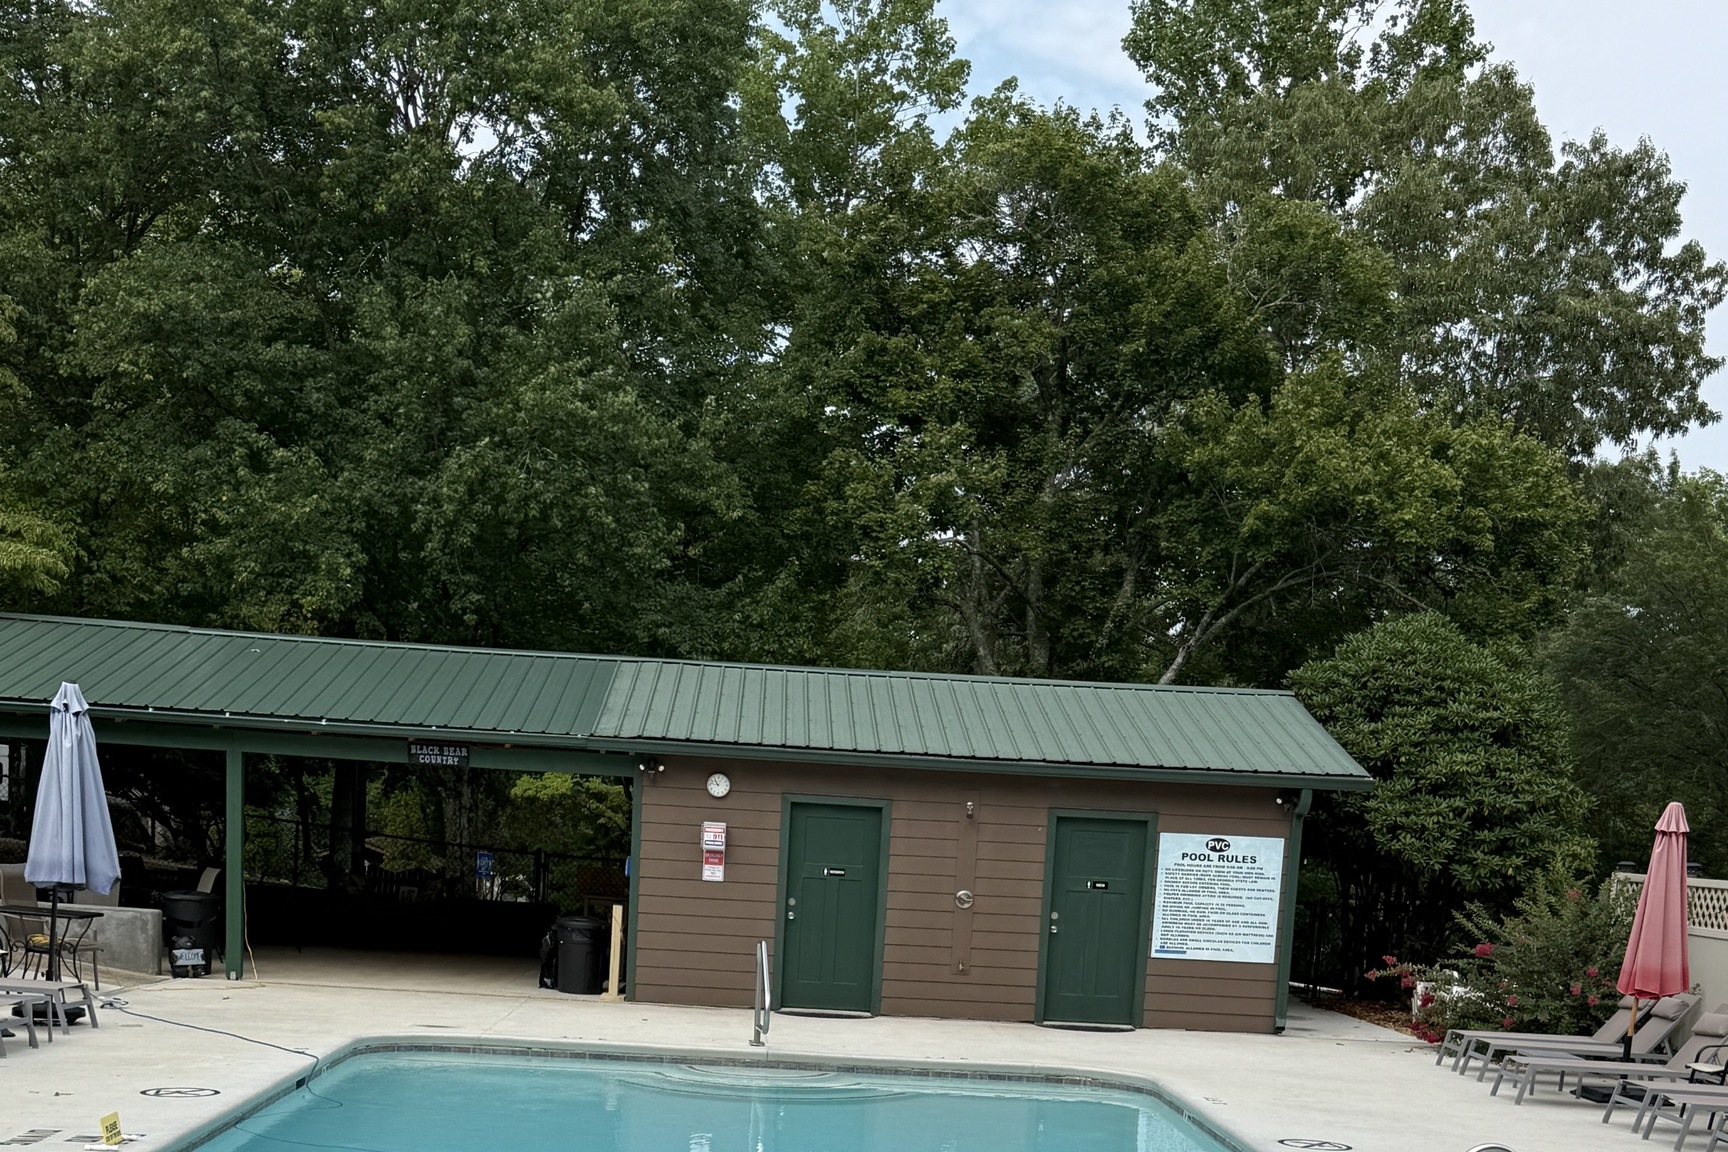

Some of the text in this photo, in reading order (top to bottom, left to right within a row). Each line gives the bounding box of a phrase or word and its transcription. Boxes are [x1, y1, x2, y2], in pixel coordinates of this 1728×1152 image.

[410, 744, 468, 756] BLACK BEAR
[419, 755, 459, 765] COUNTRY
[1207, 841, 1229, 850] PVC
[1181, 853, 1257, 863] POOL RULES
